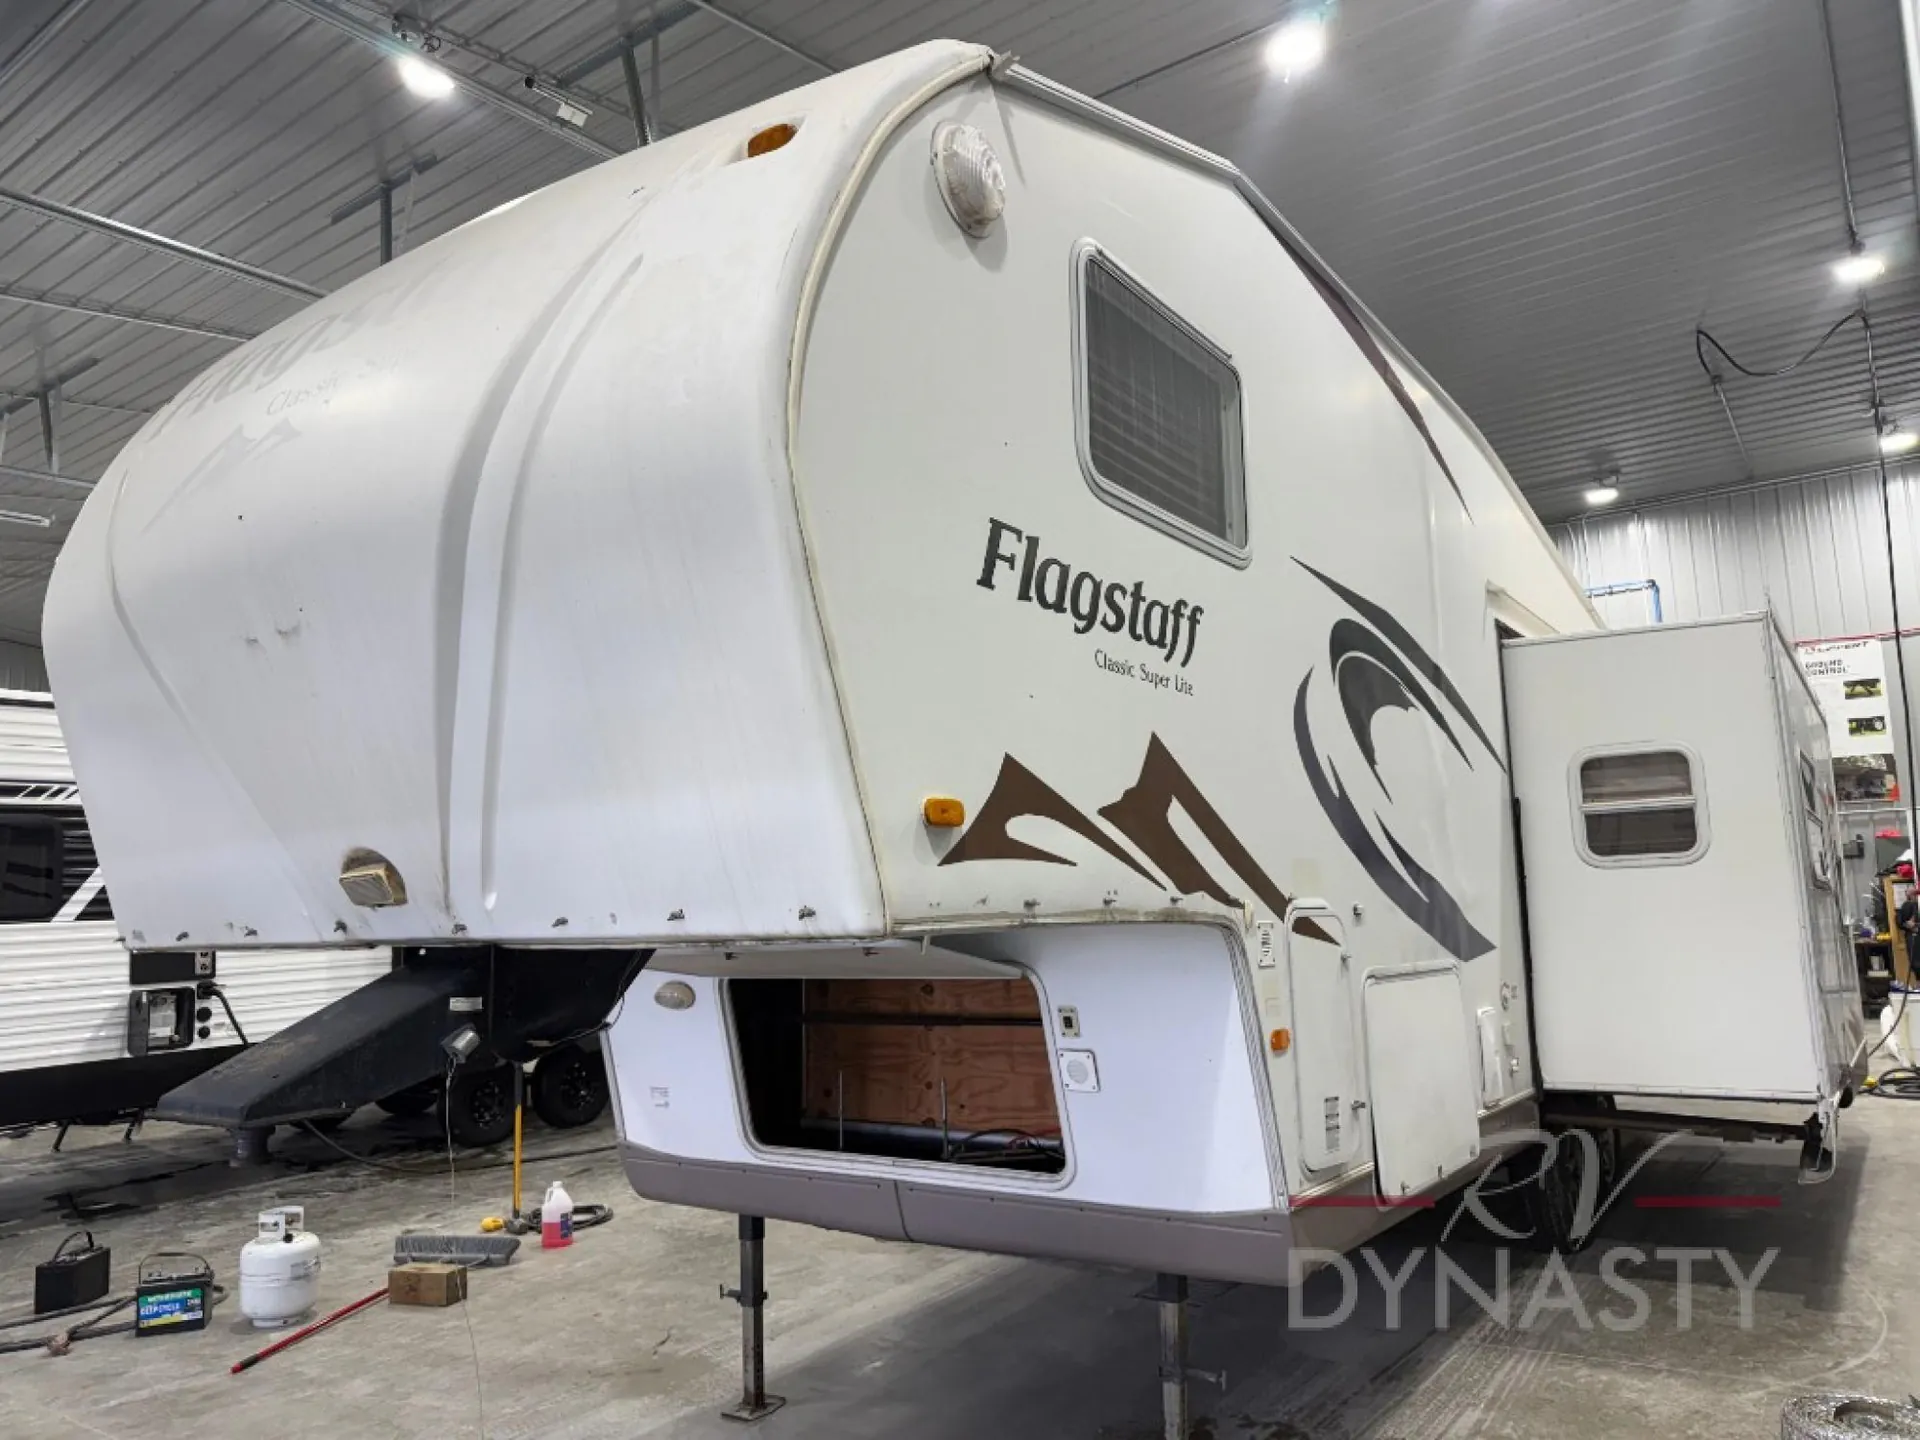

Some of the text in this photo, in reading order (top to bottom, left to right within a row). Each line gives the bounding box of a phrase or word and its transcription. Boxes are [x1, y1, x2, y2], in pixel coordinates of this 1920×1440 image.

[976, 517, 1205, 669] Flagstaff
[1094, 648, 1195, 697] Classic Super Lite
